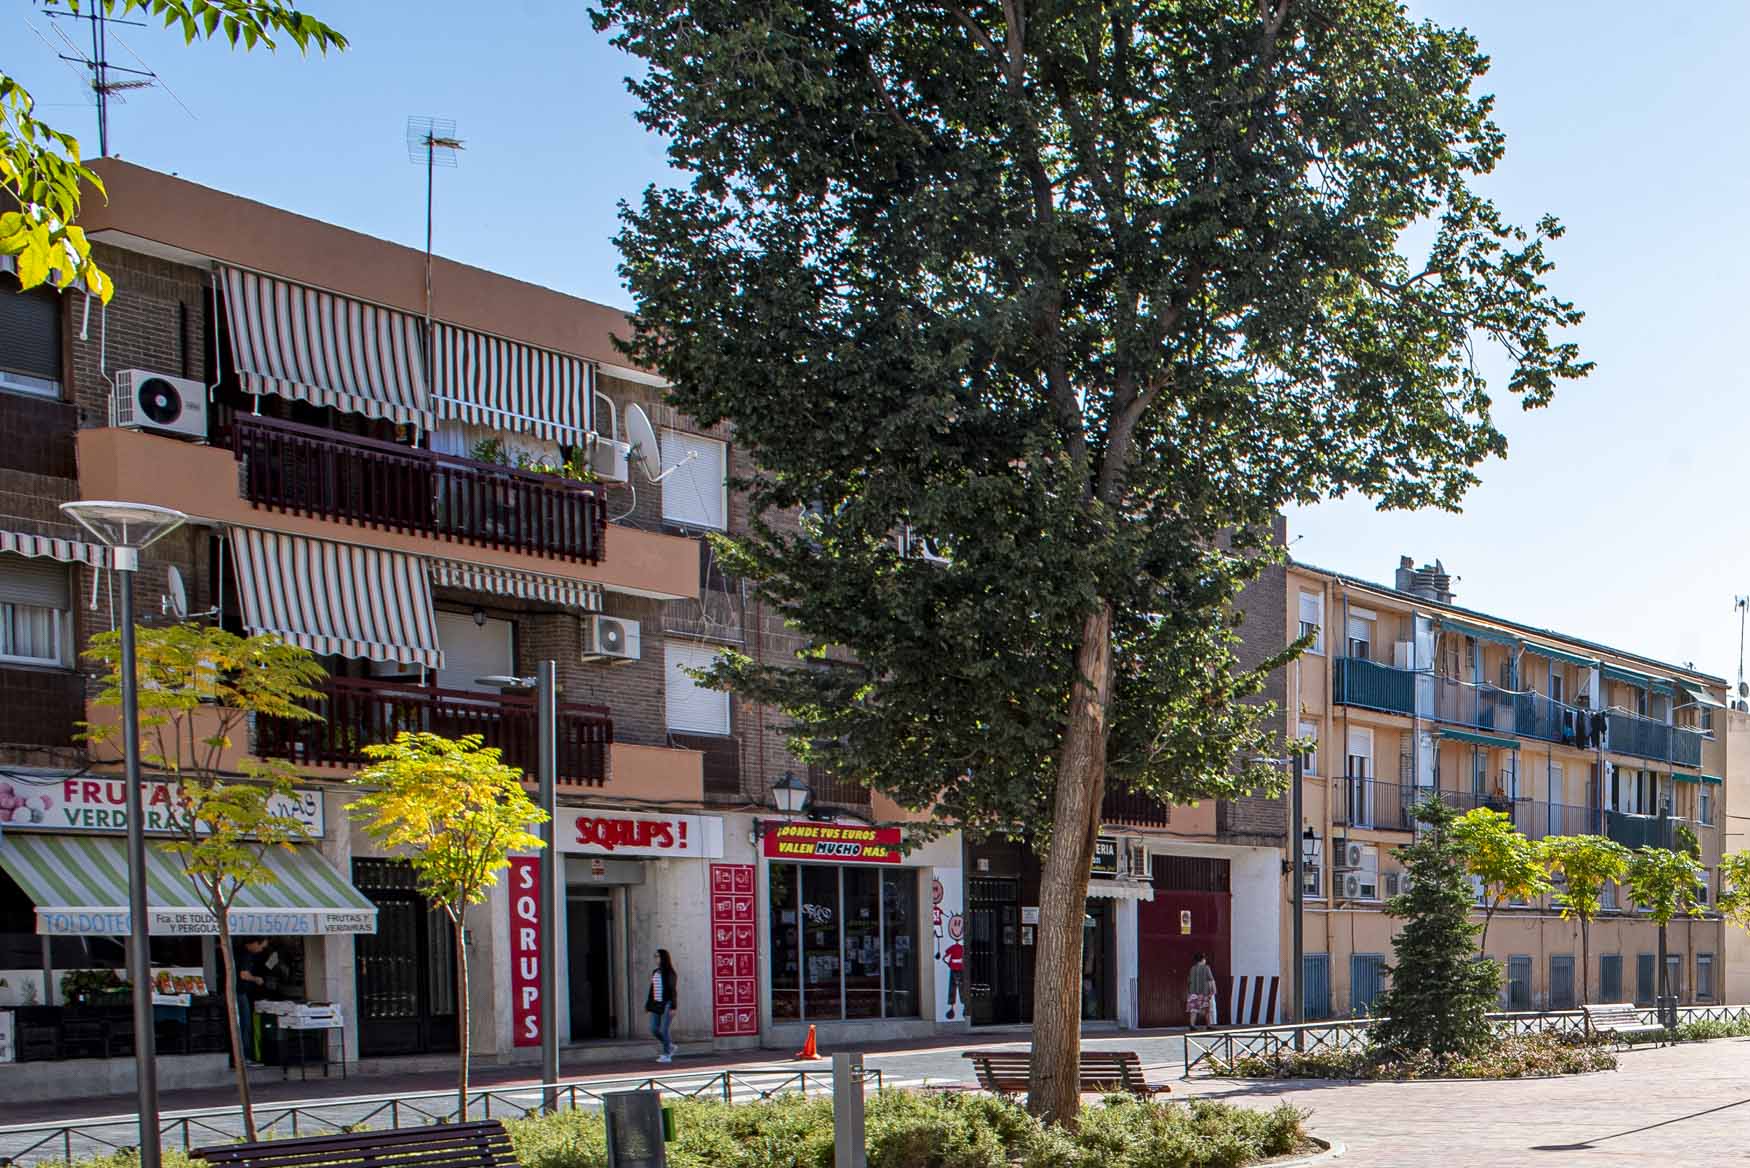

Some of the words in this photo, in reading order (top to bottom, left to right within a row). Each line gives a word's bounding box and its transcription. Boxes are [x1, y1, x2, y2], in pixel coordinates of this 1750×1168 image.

[64, 808, 193, 832] VERDRAS
[820, 827, 840, 838] TUS
[842, 829, 875, 840] EUROS
[779, 842, 814, 853] VALEN
[816, 842, 860, 855] MUCHO
[327, 914, 362, 922] FRUTAS
[517, 865, 538, 1039] SQRUPS
